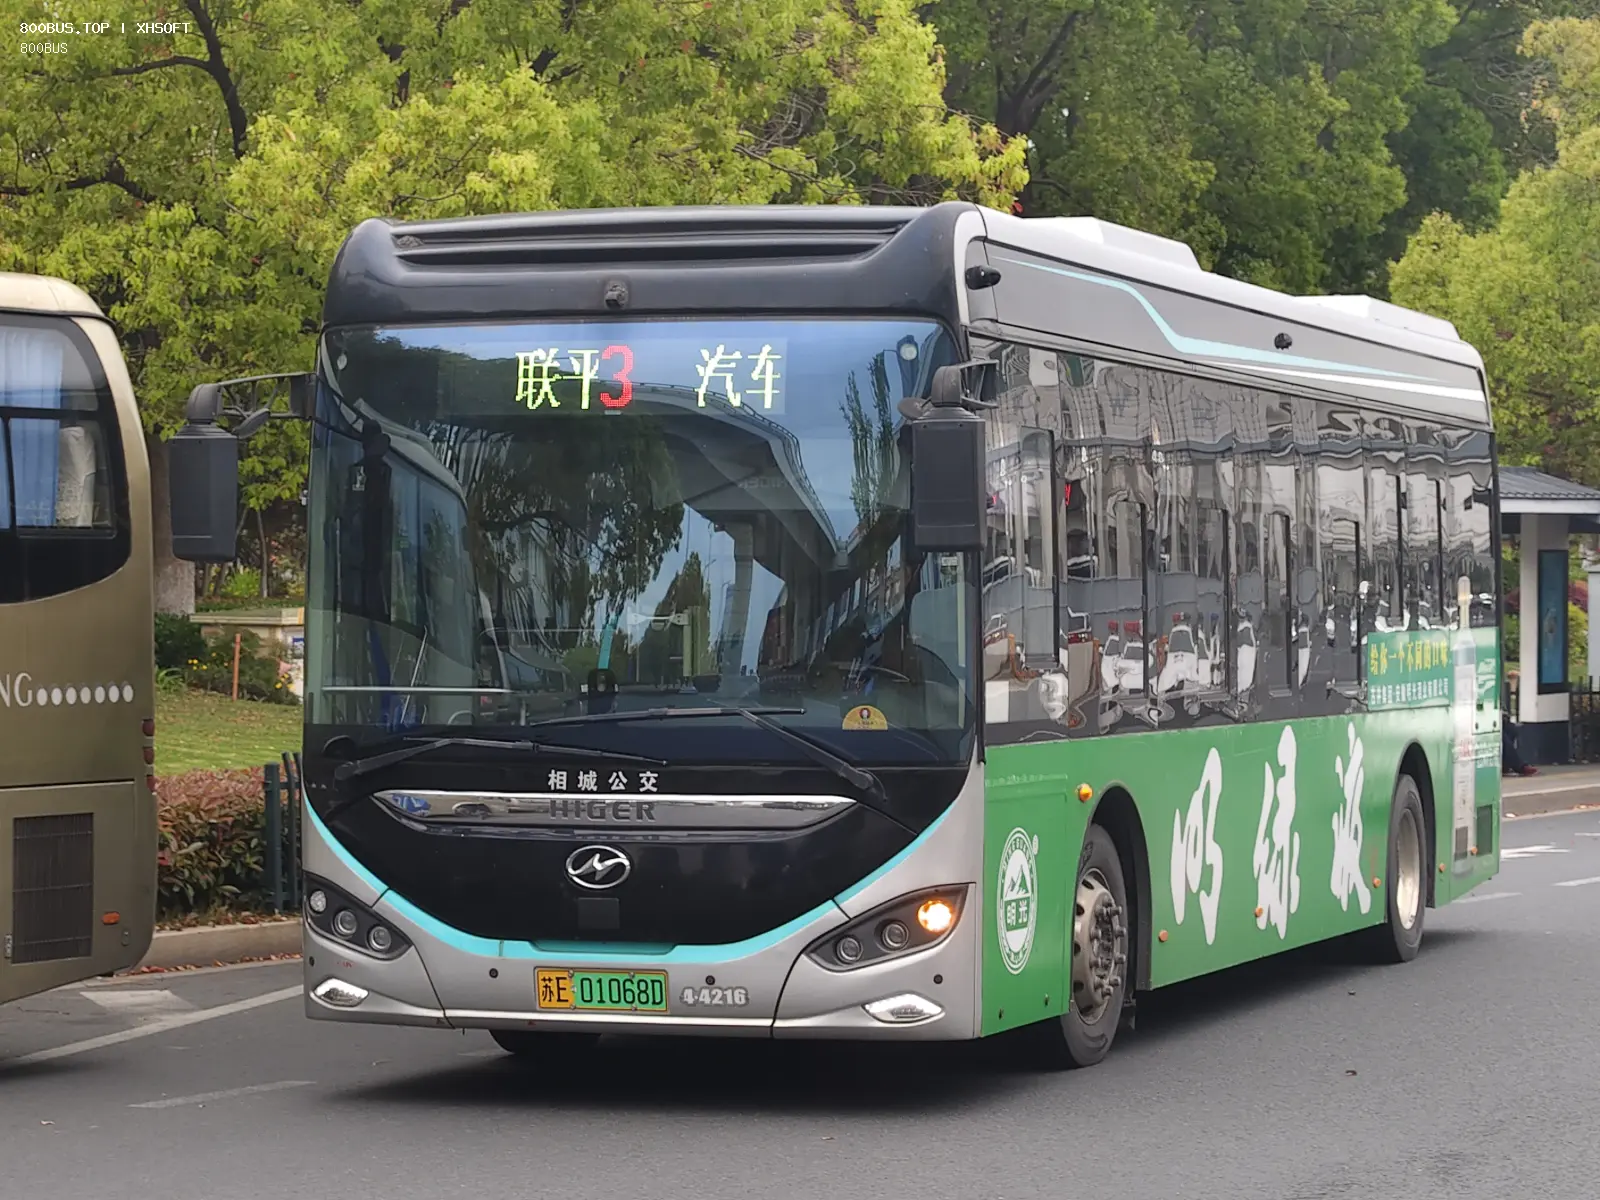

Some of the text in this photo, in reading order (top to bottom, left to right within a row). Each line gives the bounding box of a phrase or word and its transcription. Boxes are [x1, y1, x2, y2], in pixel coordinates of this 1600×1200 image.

[695, 344, 782, 409] 汽车
[548, 769, 659, 793] 相城公交
[550, 800, 656, 822] HIGER
[1006, 899, 1028, 926] 明光
[541, 977, 664, 1006] 苏E 01068D
